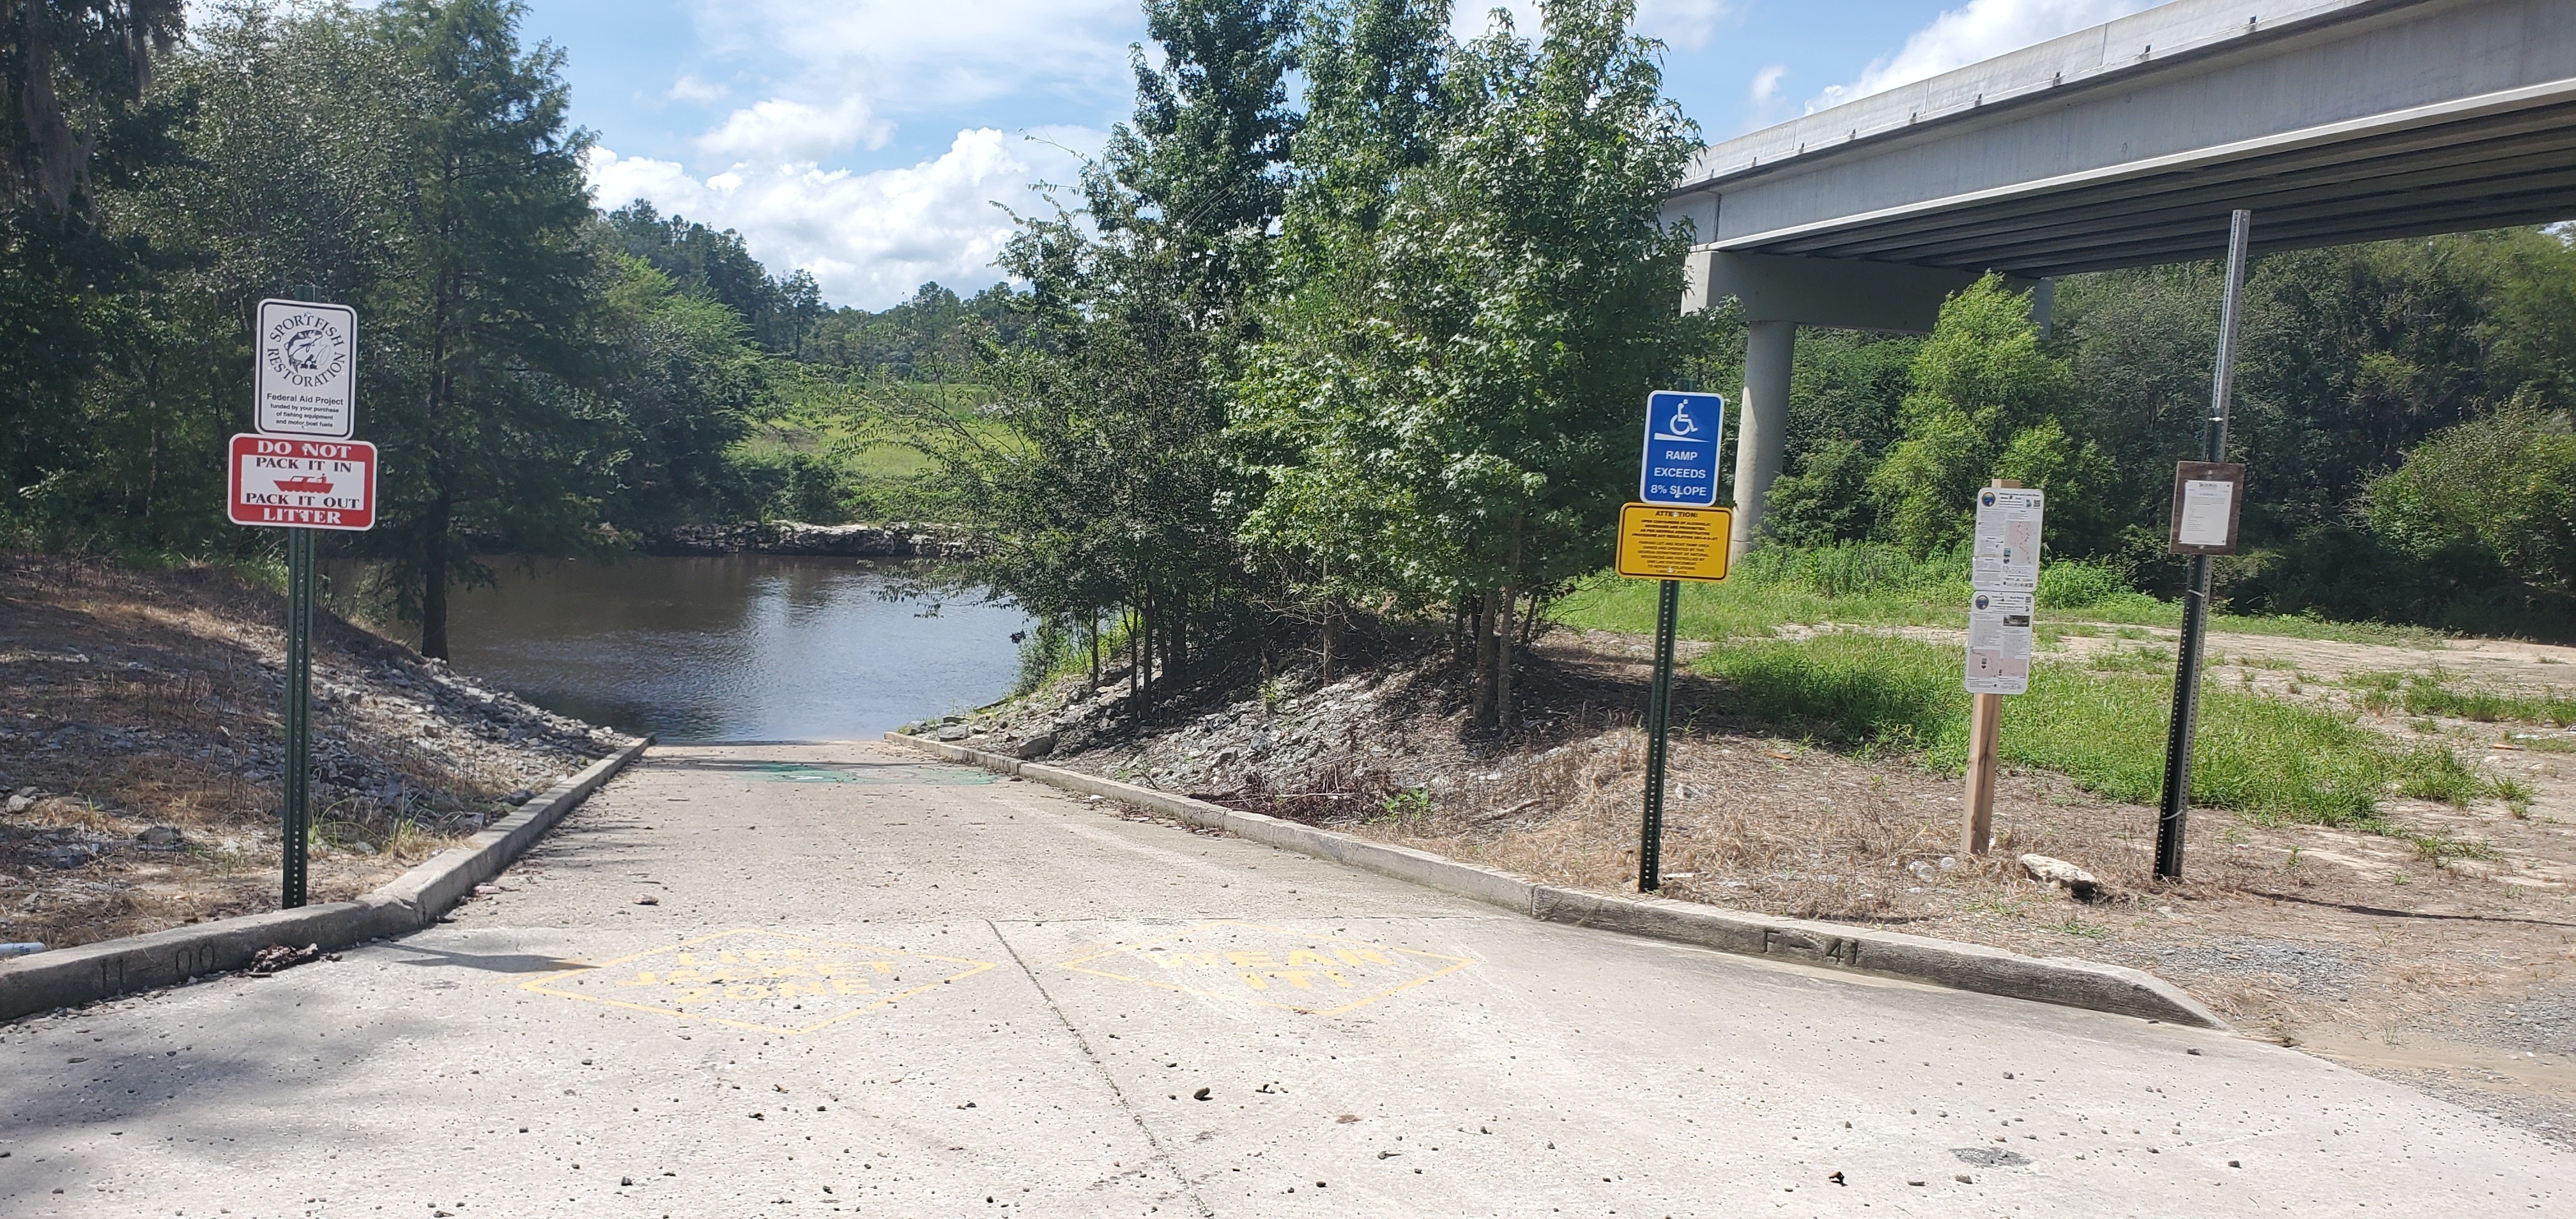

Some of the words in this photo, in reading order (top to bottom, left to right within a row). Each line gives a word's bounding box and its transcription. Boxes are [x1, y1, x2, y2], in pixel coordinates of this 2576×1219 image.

[267, 348, 346, 387] RESTORATION
[266, 393, 297, 402] Federal
[315, 396, 344, 406] Project
[257, 440, 292, 454] DO
[302, 443, 351, 459] NOT
[1666, 450, 1698, 461] RAMP
[256, 457, 300, 470] PACK
[309, 460, 325, 470] IT
[334, 462, 351, 472] IN
[1654, 467, 1706, 479] EXCEEDS
[1650, 484, 1667, 494] 8%
[1669, 485, 1707, 496] SLOPE
[246, 493, 289, 505] PACK
[298, 496, 315, 505] IT
[323, 497, 360, 509] OUT
[263, 508, 342, 524] LITTER
[1151, 949, 1395, 969] WEAR
[615, 960, 898, 986] JACKET
[672, 978, 875, 1004] ZONE
